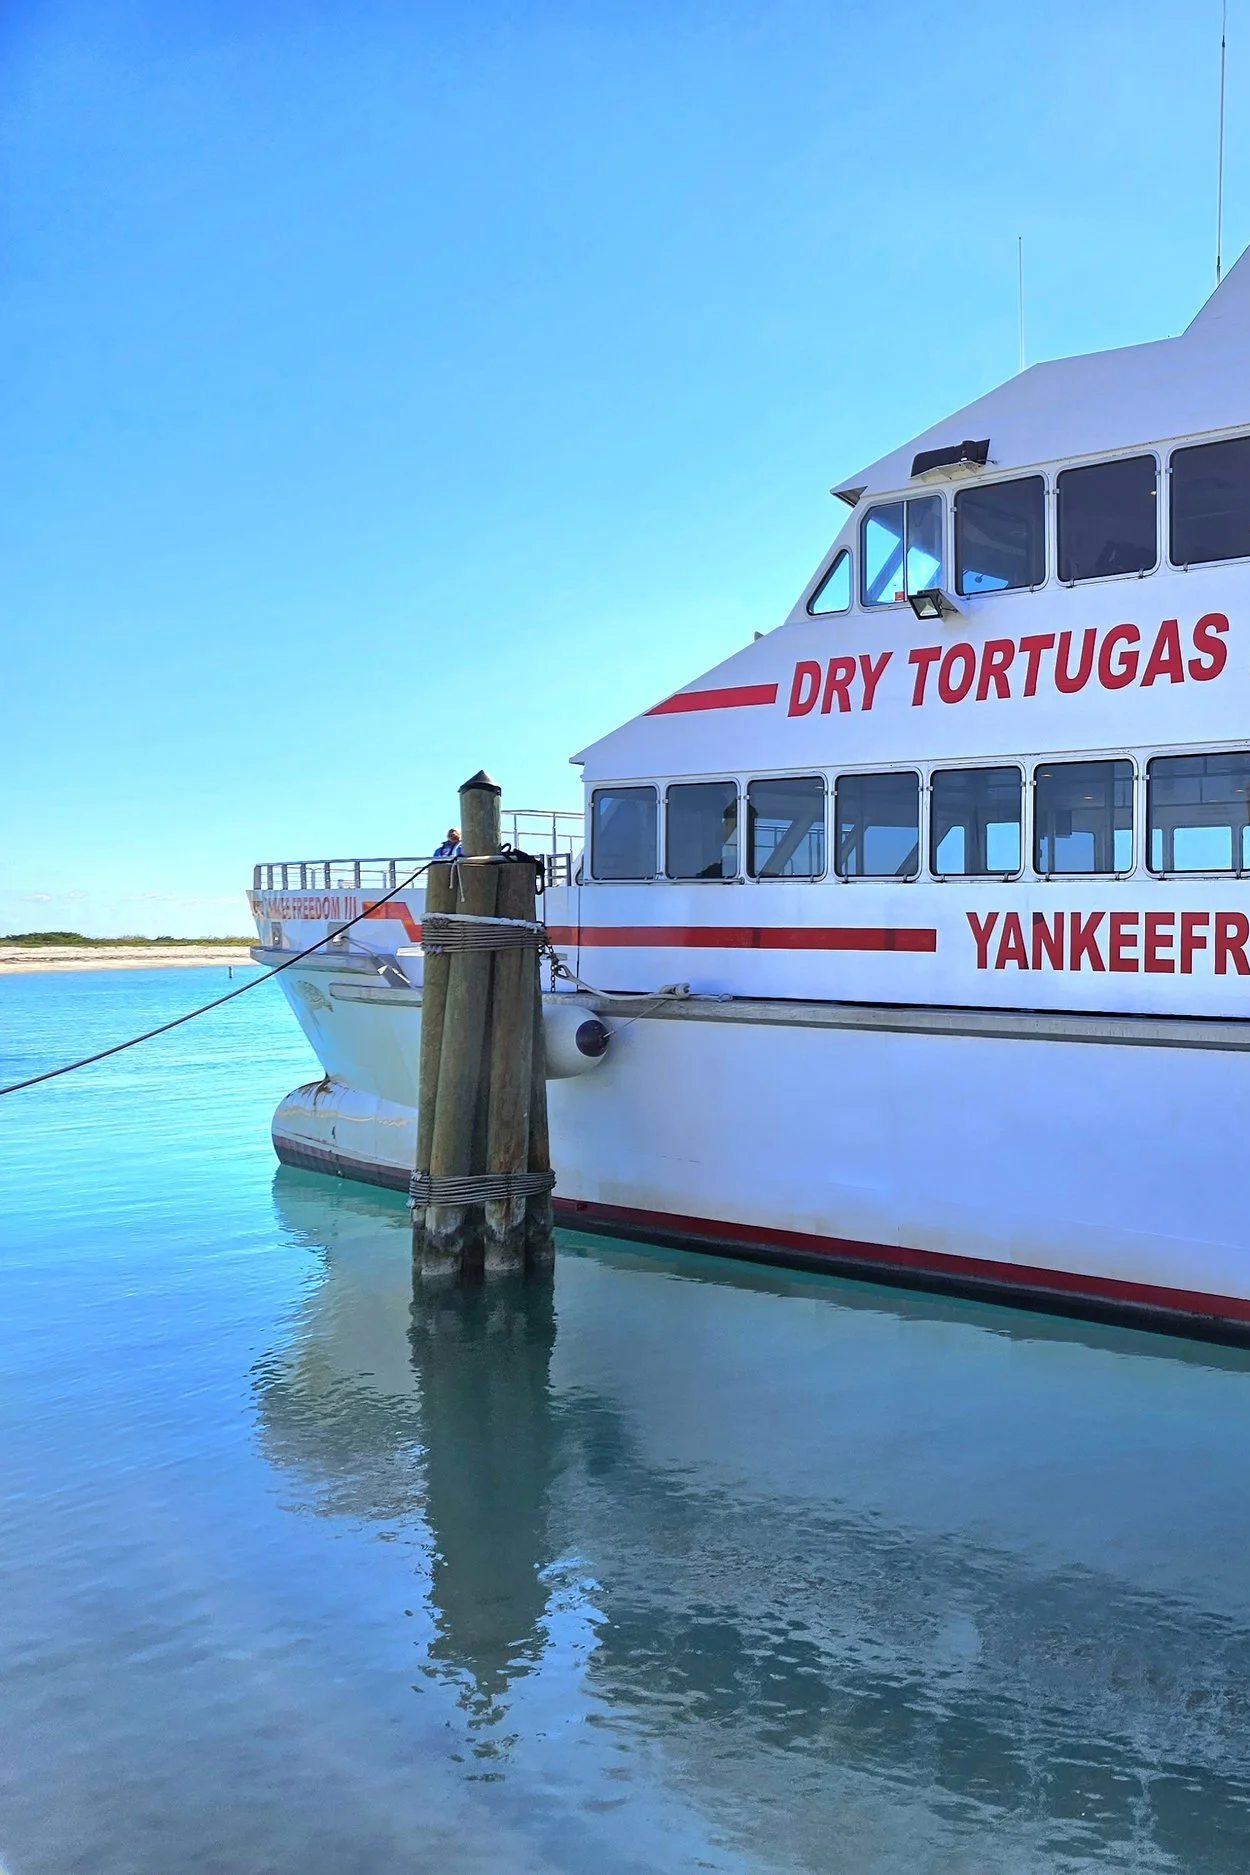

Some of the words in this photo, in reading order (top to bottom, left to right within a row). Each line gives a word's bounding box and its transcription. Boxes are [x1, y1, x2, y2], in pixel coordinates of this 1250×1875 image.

[788, 652, 891, 718] DRY
[909, 612, 1230, 706] TORTUGAS
[292, 896, 340, 919] FREEDOM
[344, 896, 357, 919] III
